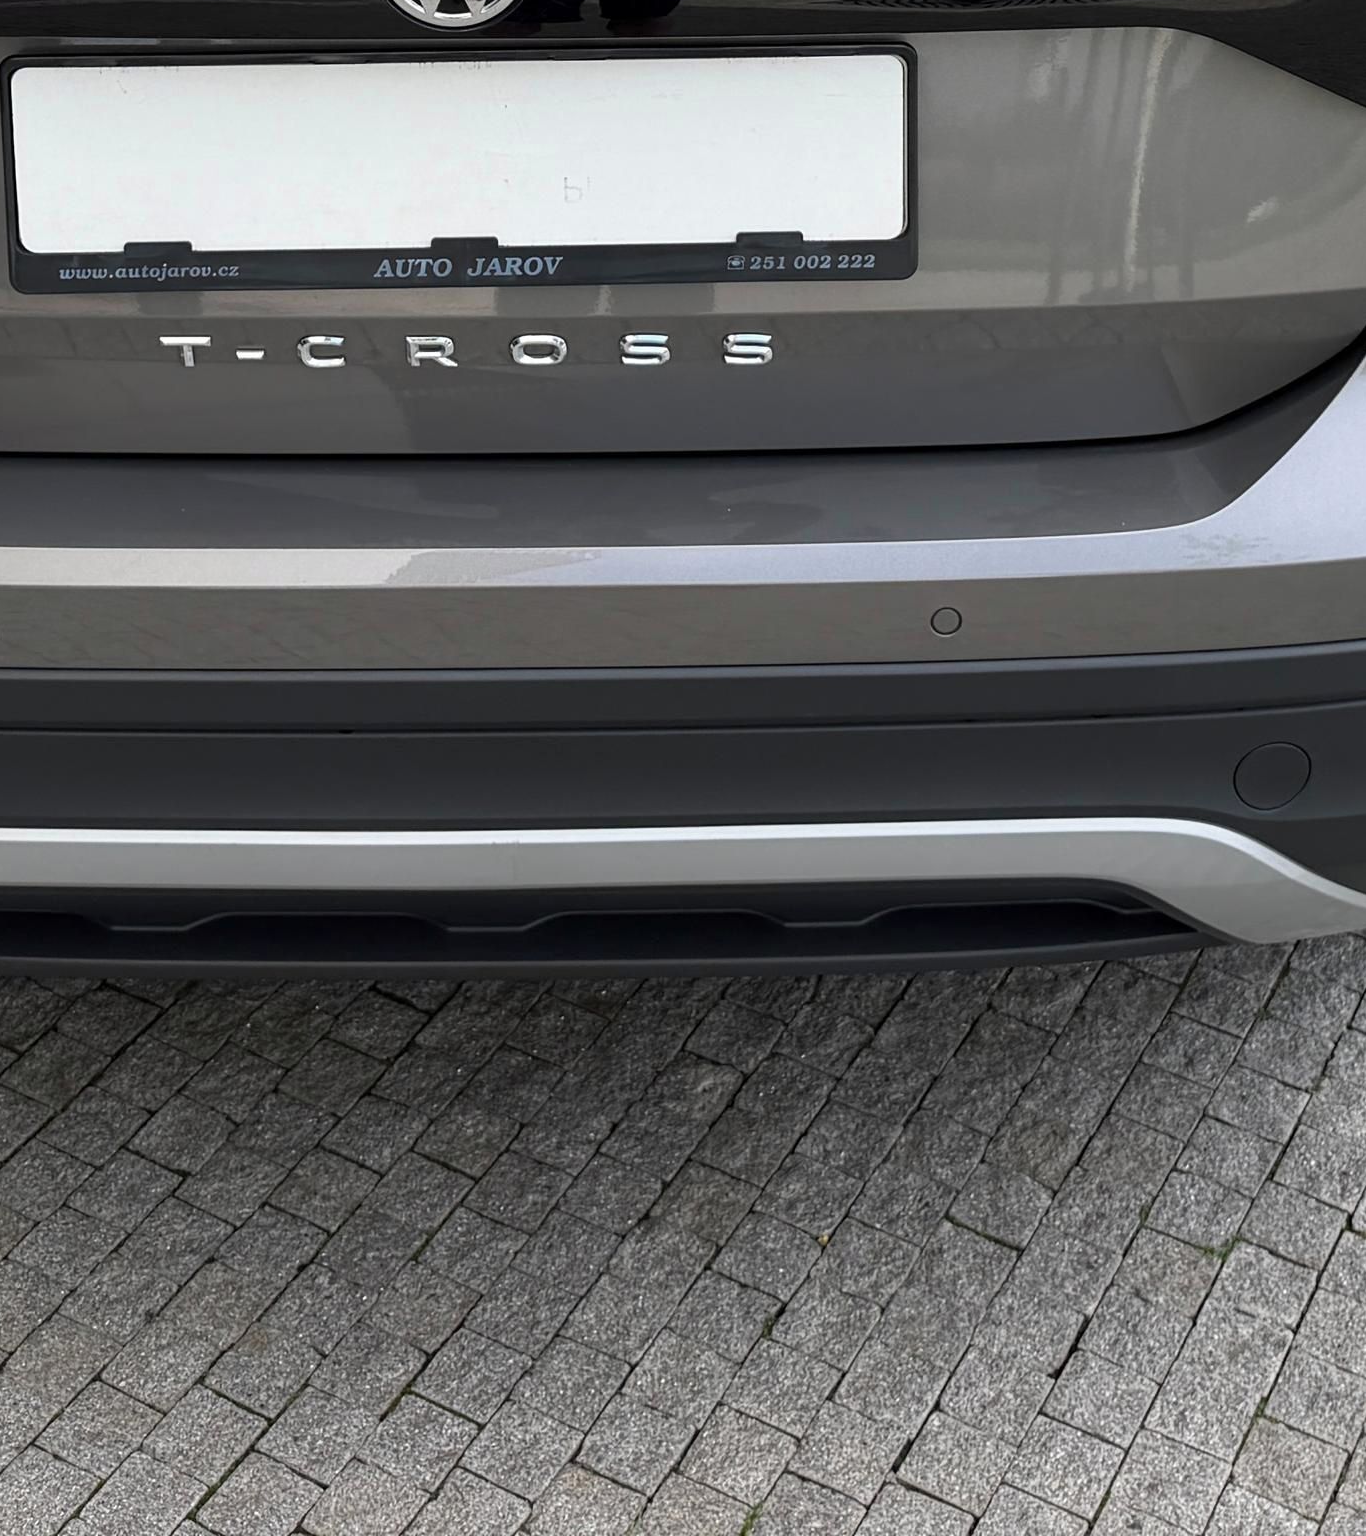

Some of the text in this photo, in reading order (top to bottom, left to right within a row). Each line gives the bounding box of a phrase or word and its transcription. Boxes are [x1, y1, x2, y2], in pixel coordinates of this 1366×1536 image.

[59, 263, 240, 281] www.autojarov.cz
[374, 256, 564, 278] AUTO JAROV
[750, 254, 876, 270] 251 002 222
[159, 333, 773, 368] T-CROSS
